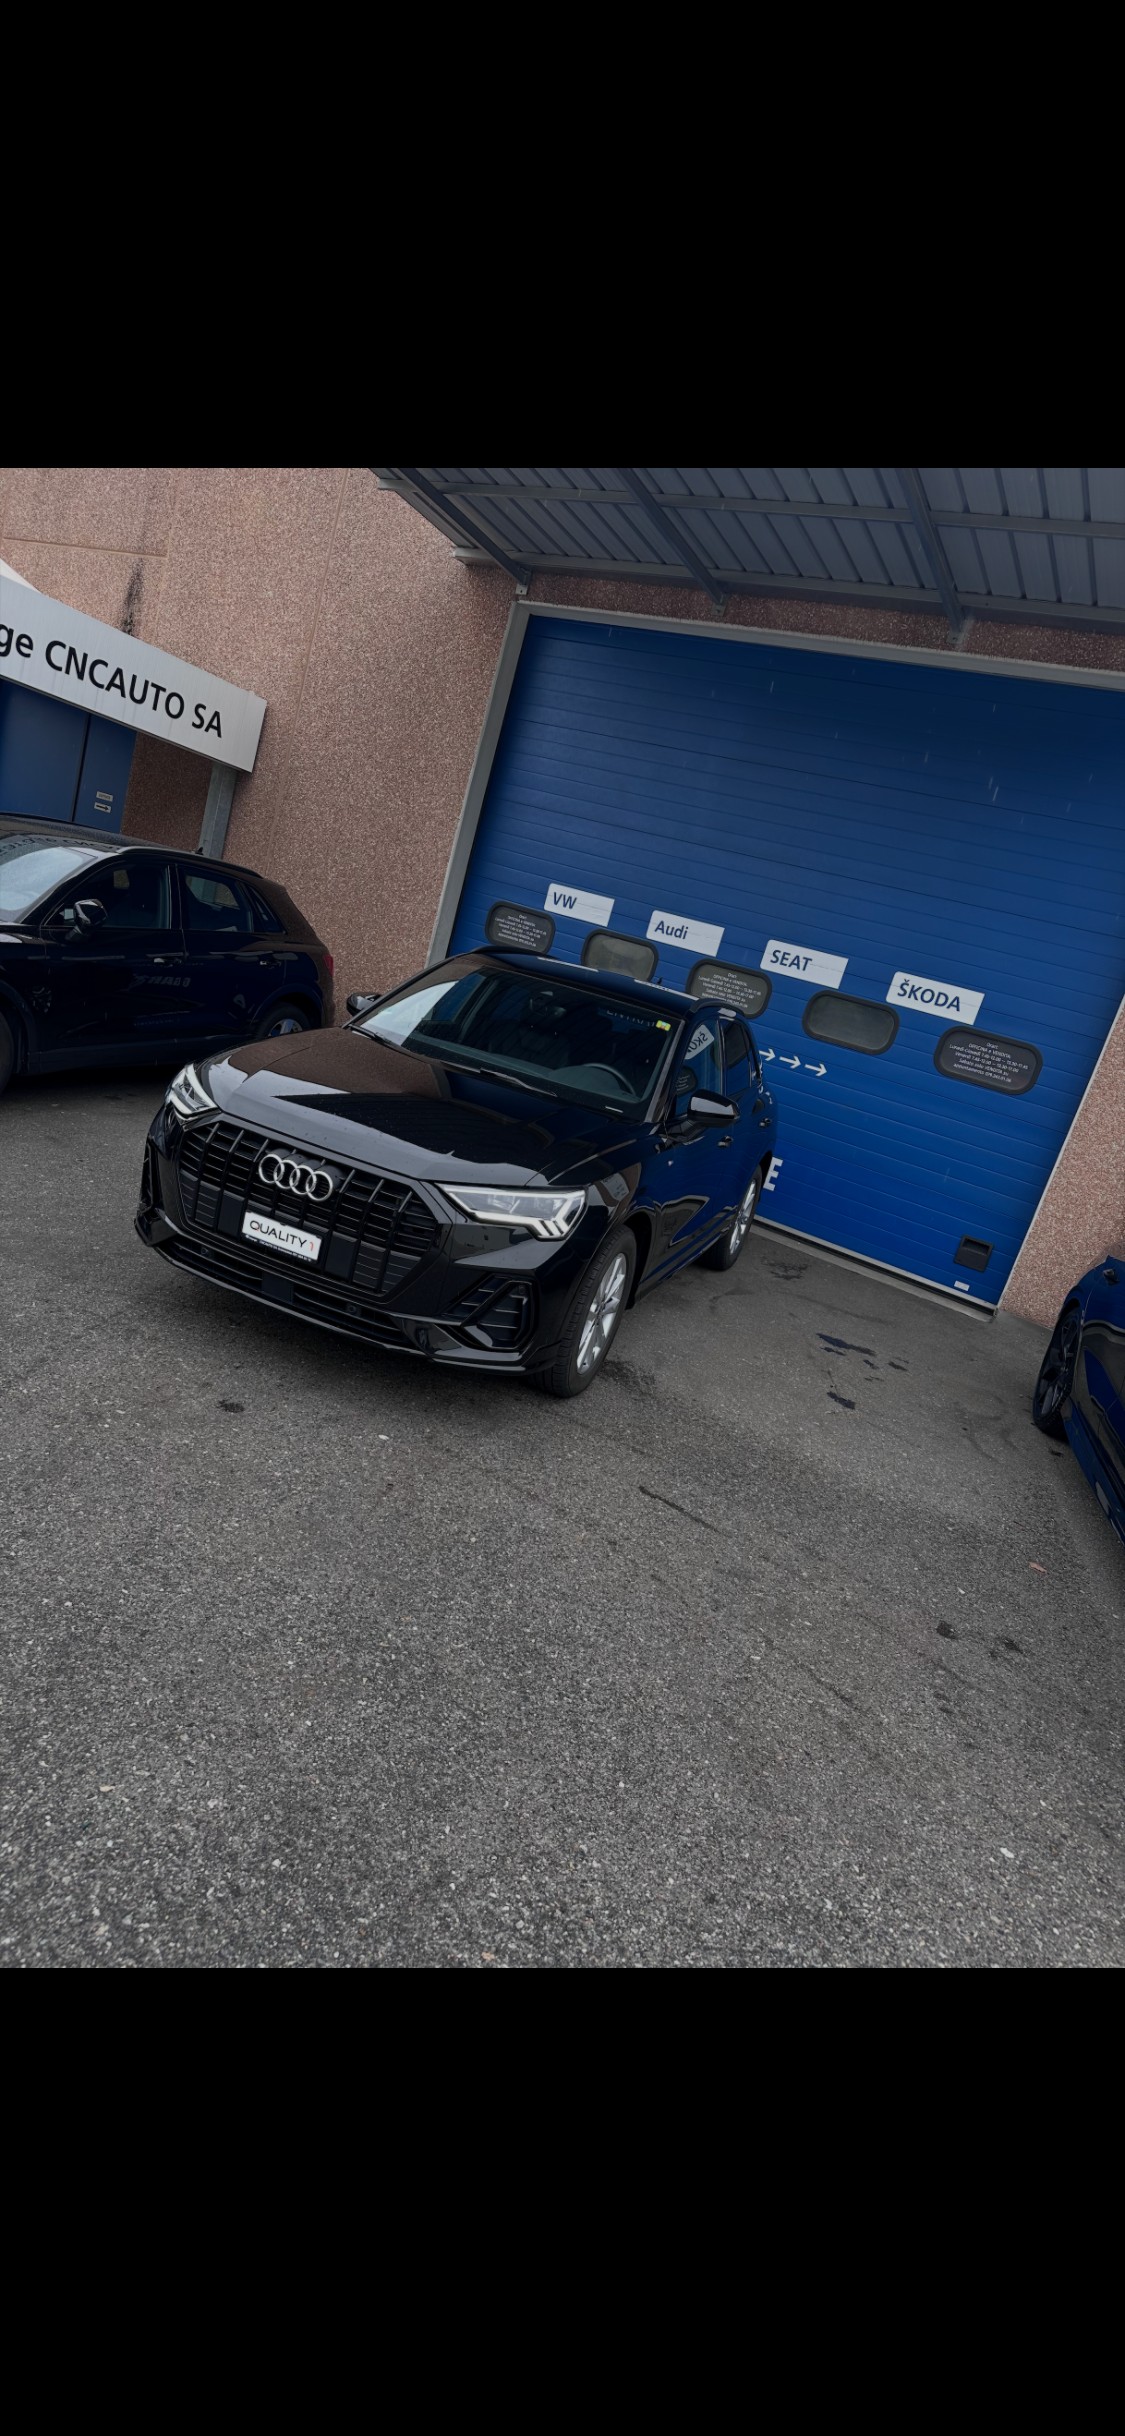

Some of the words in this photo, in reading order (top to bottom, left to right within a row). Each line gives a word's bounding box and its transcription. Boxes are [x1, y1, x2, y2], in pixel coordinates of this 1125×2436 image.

[45, 640, 185, 719] CNCAUTO
[191, 703, 223, 738] SA
[553, 892, 577, 909] VW
[655, 921, 689, 939] Audi
[769, 949, 812, 971] SEAT
[897, 978, 961, 1011] ŠKODA
[249, 1220, 307, 1248] QUALITY
[310, 1241, 314, 1252] 1
